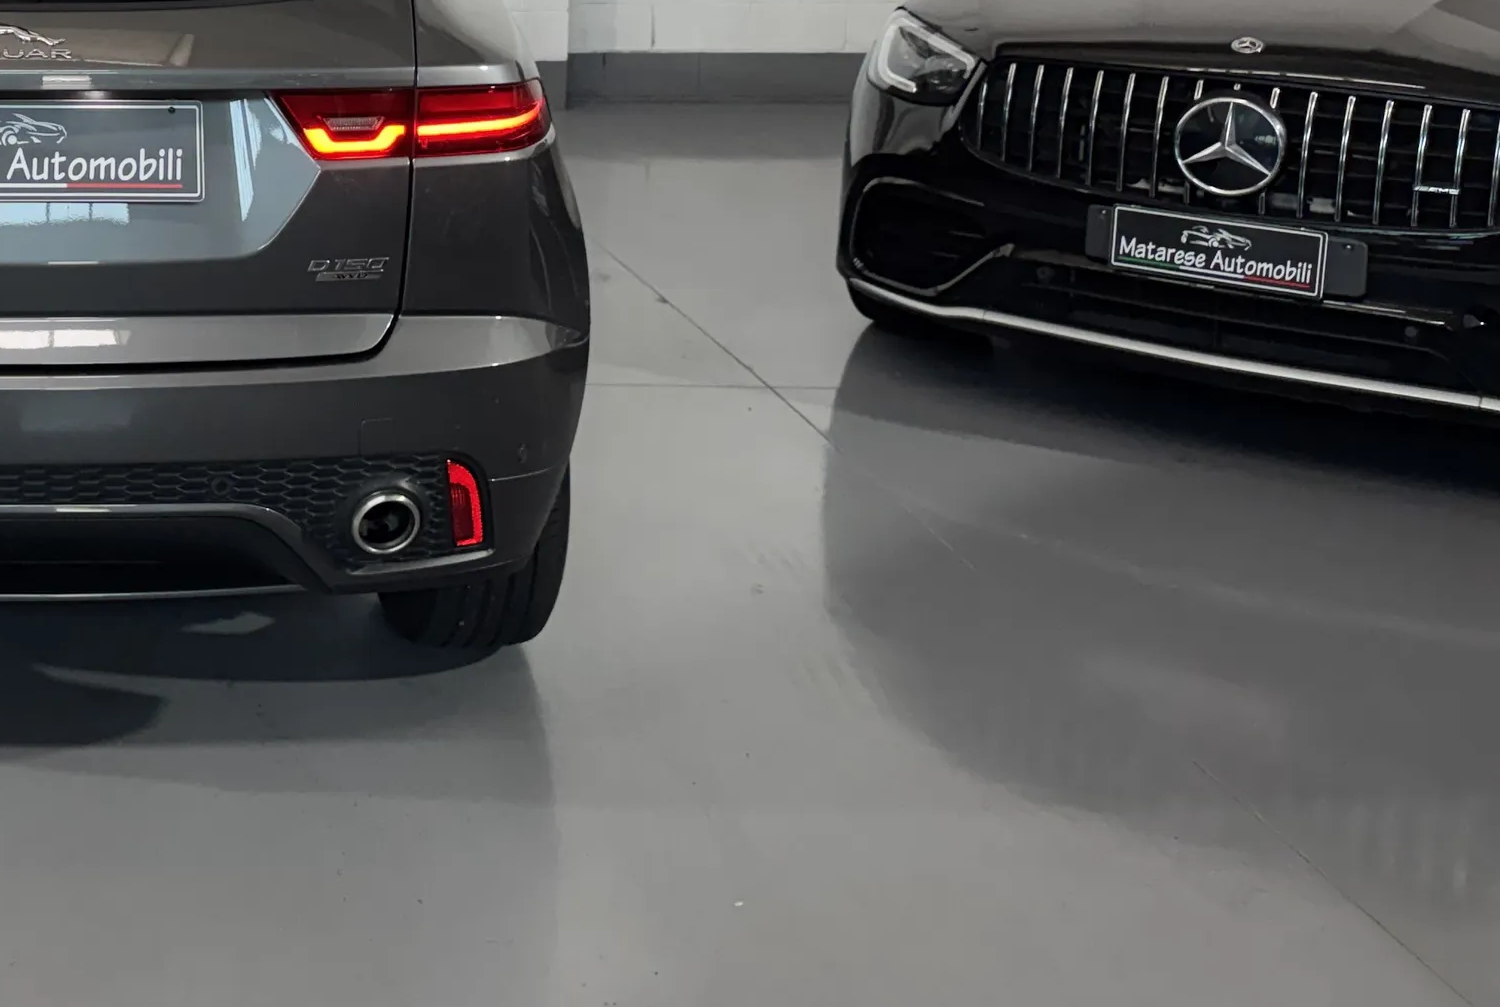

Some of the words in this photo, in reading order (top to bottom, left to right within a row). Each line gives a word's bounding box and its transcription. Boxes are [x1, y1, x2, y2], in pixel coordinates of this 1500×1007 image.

[6, 147, 183, 182] Automobili
[1119, 236, 1206, 269] Matarese
[1210, 250, 1312, 285] Automobili
